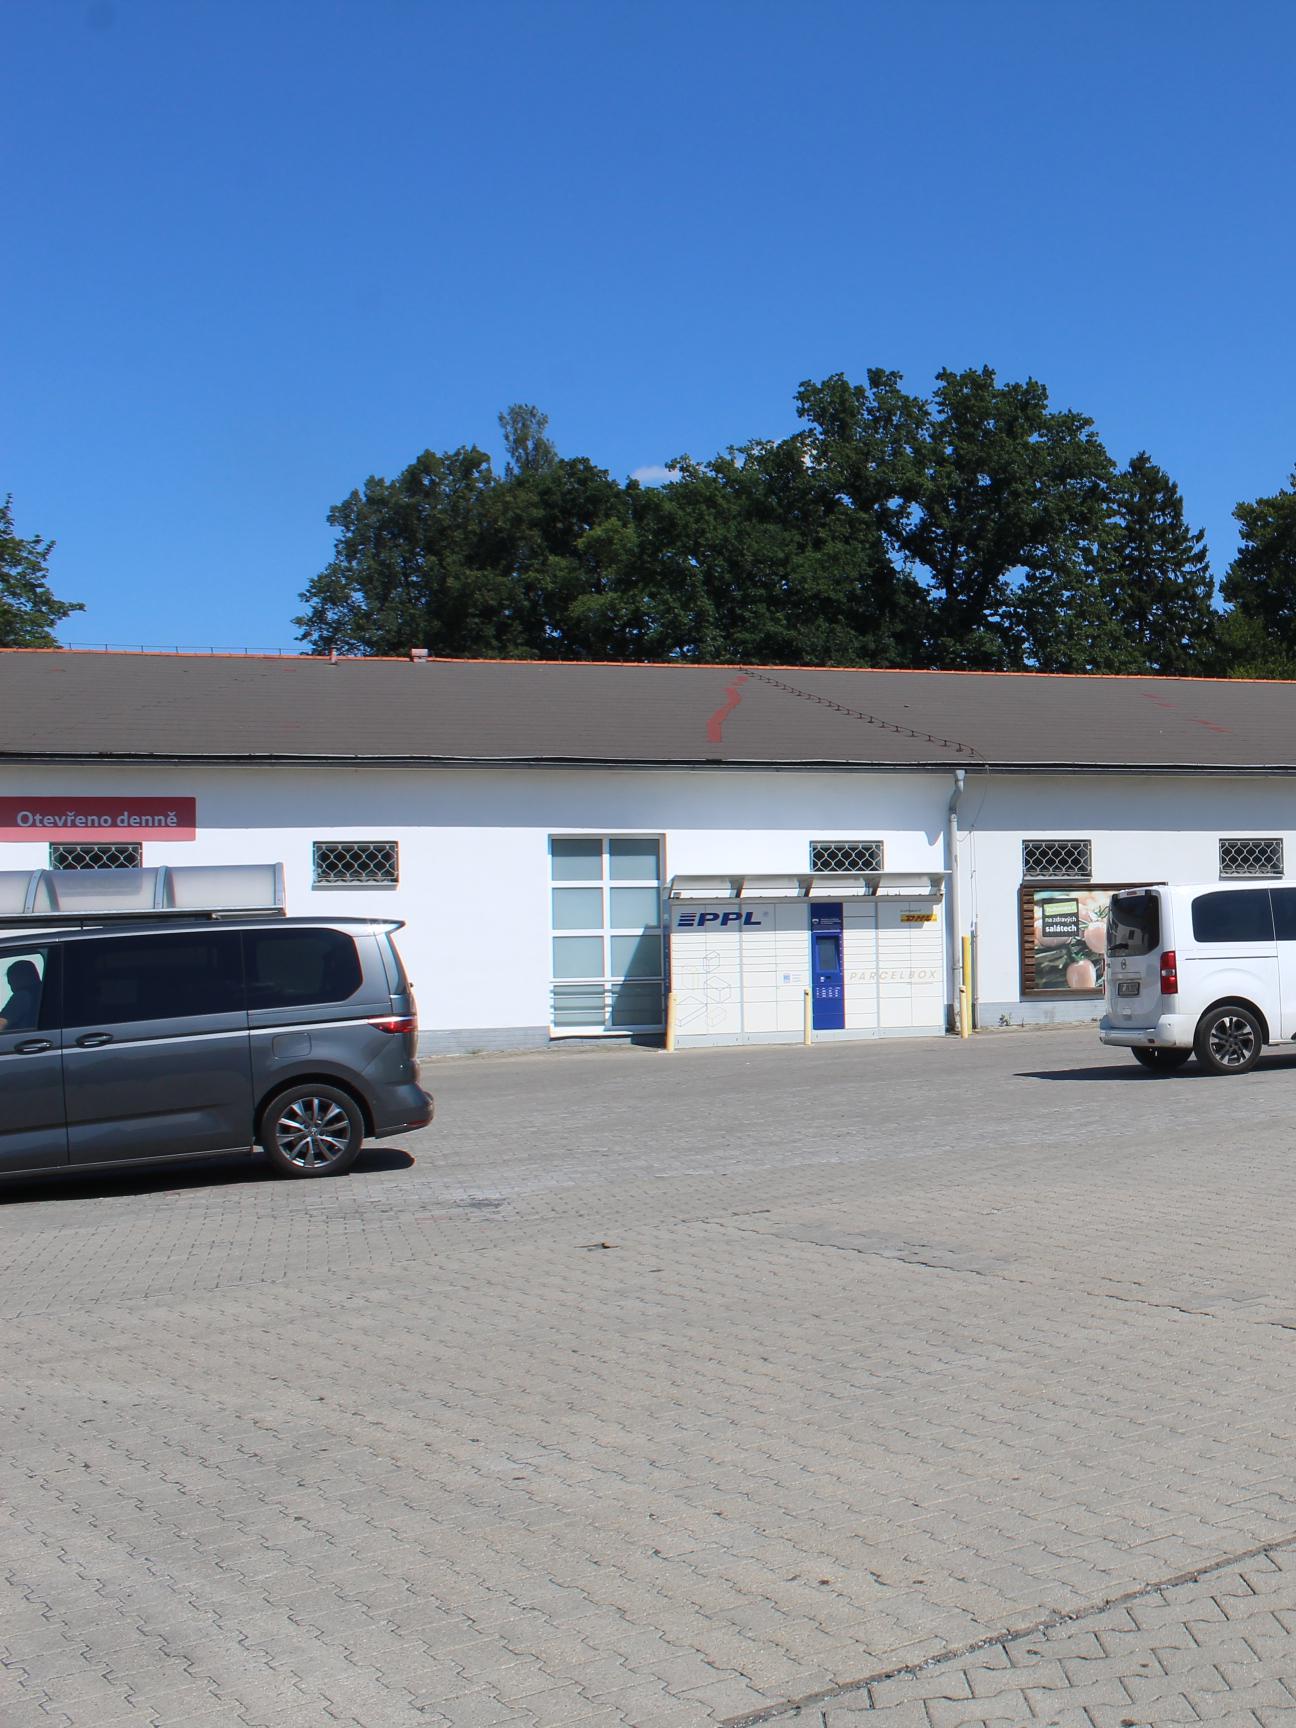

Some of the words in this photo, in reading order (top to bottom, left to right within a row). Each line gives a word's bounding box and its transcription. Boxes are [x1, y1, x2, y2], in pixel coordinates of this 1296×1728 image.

[16, 811, 112, 827] Otevřeno
[116, 811, 178, 827] denně
[697, 911, 762, 927] PPL
[1053, 916, 1077, 924] zdravých
[1045, 924, 1077, 932] salátech
